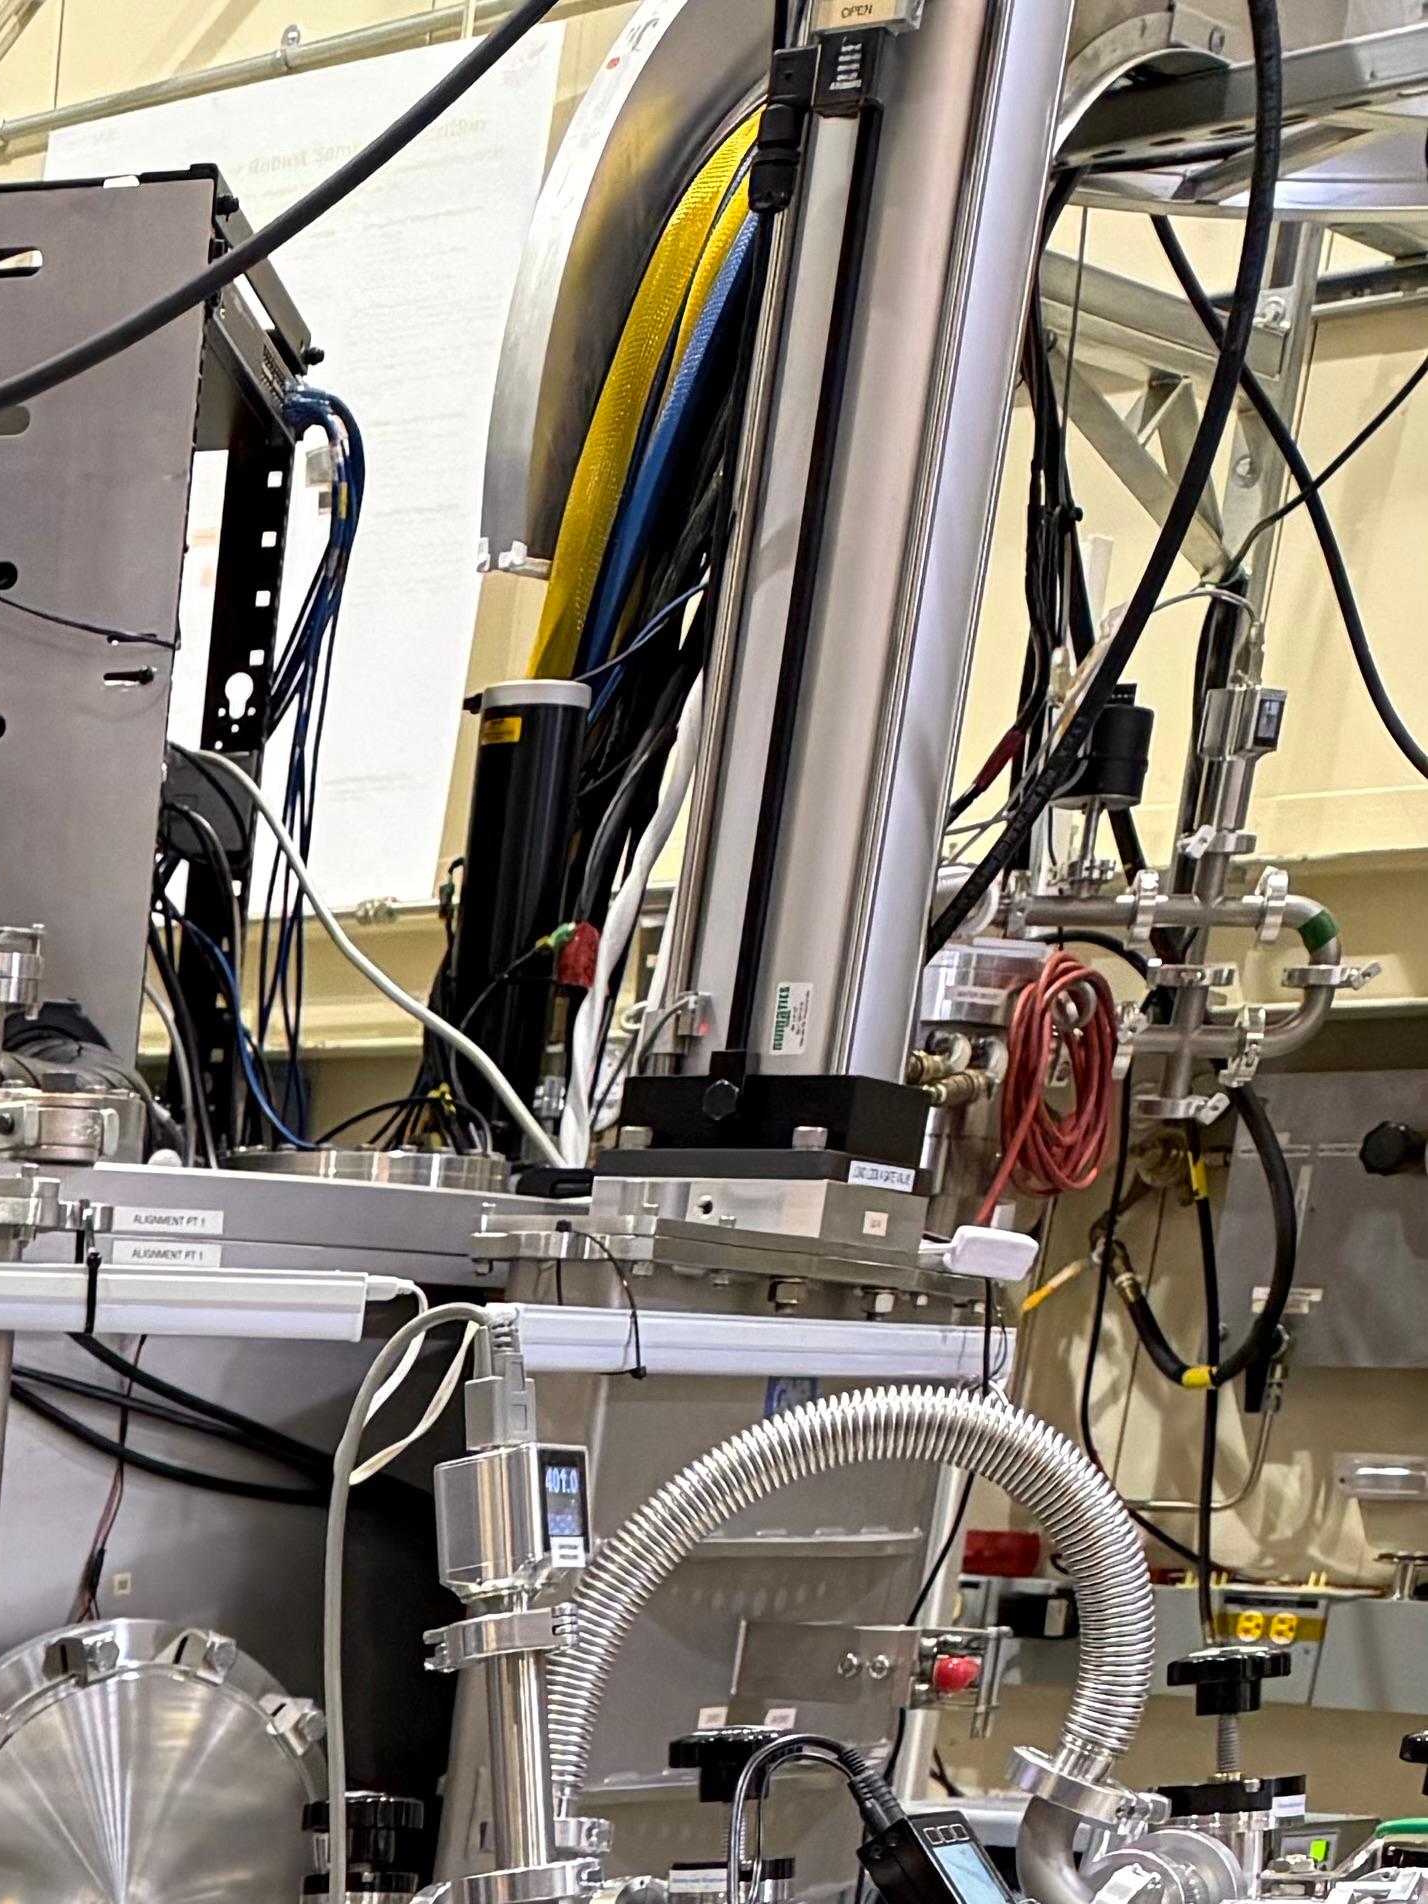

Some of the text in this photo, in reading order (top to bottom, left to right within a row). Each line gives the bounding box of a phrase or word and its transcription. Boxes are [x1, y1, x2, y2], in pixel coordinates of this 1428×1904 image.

[840, 4, 873, 19] OPEN
[133, 1213, 184, 1226] ALIGNMENT
[186, 1215, 198, 1226] PT
[131, 1248, 183, 1260] ALIGNMENT
[184, 1249, 196, 1261] PT
